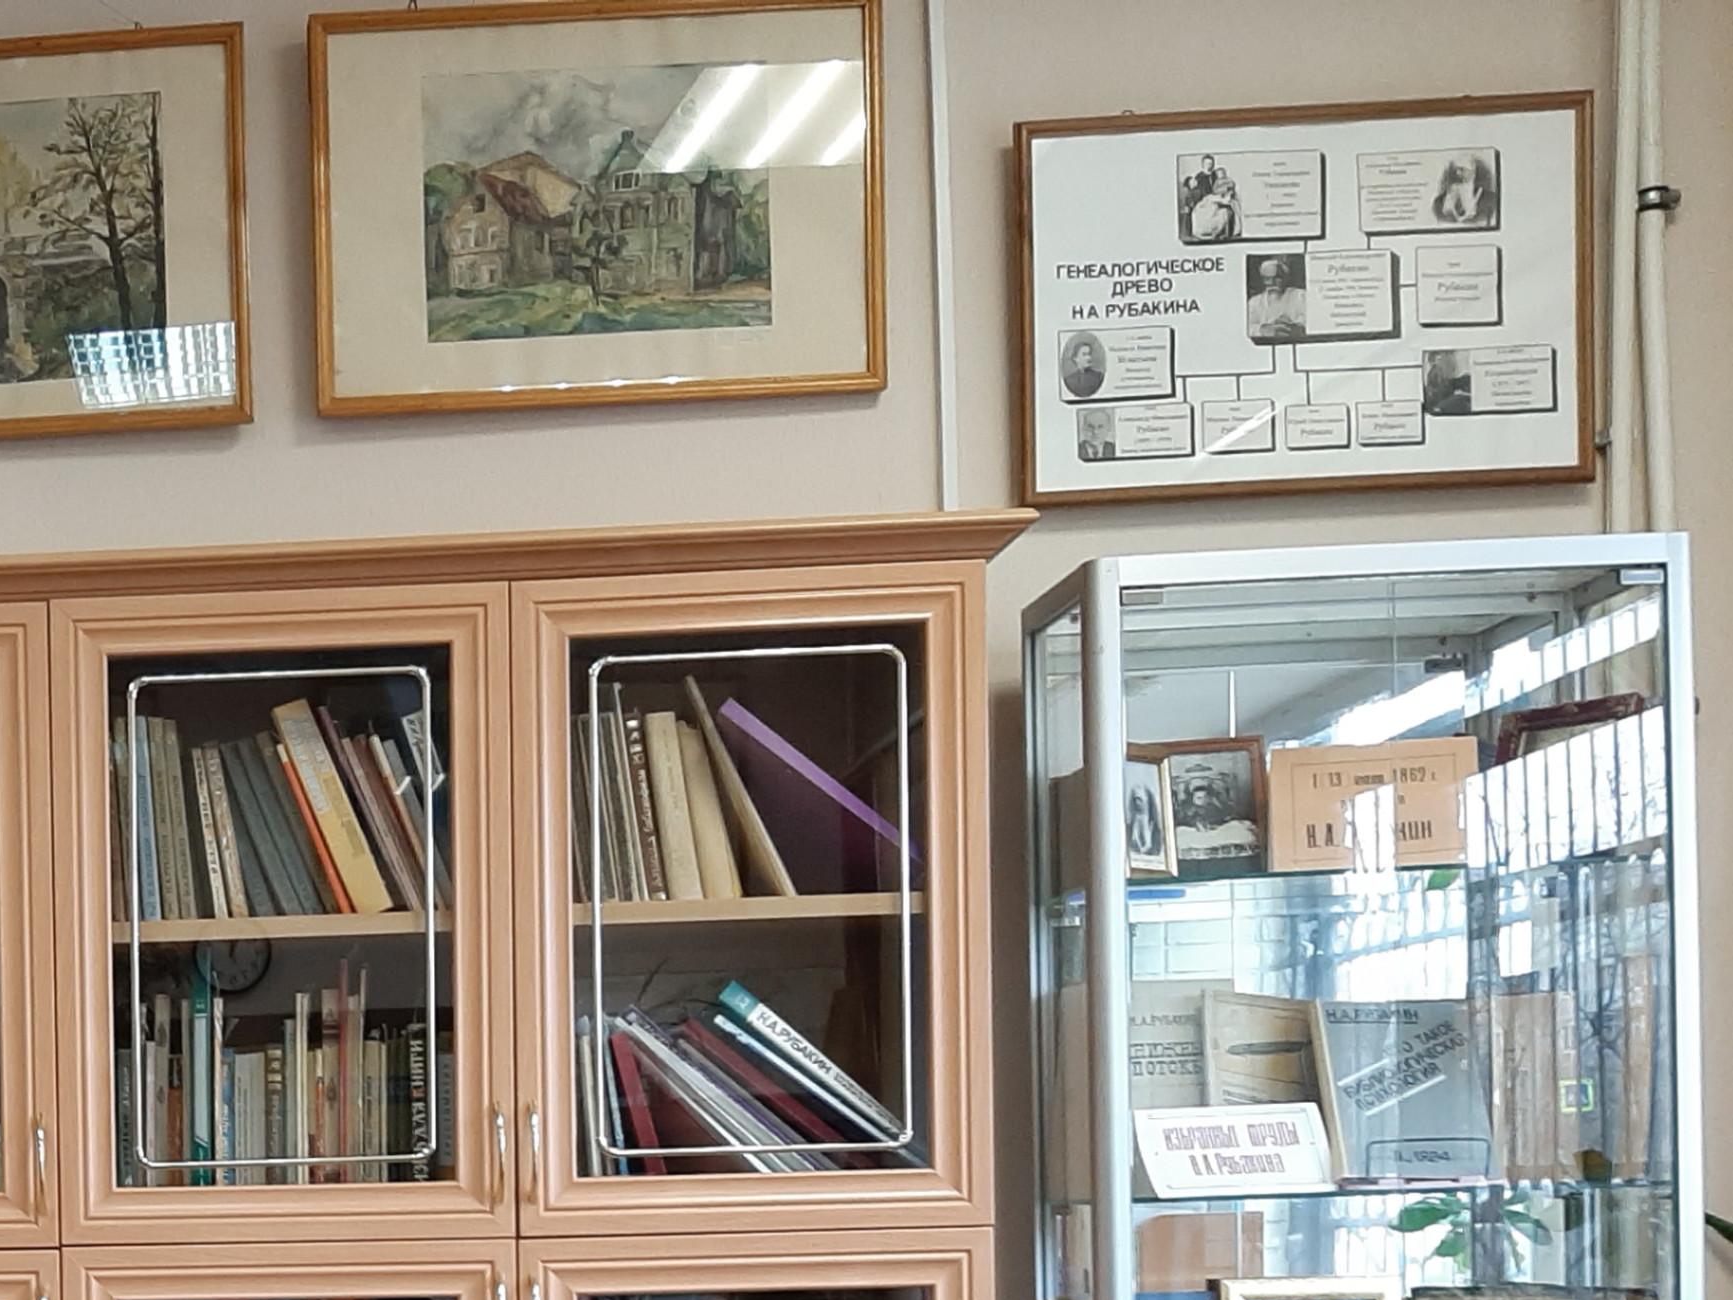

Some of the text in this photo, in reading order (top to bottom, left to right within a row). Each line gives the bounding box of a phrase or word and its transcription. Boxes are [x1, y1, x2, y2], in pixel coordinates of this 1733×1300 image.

[1056, 257, 1225, 279] ГЕНЕАЛОГИЧЕСКОЕ
[1111, 278, 1173, 298] ДРЕВО
[1105, 299, 1200, 318] РУБАКИНА
[1393, 766, 1426, 783] 1862
[409, 1040, 426, 1098] КНИГИ
[412, 1102, 427, 1138] ДЛЯ
